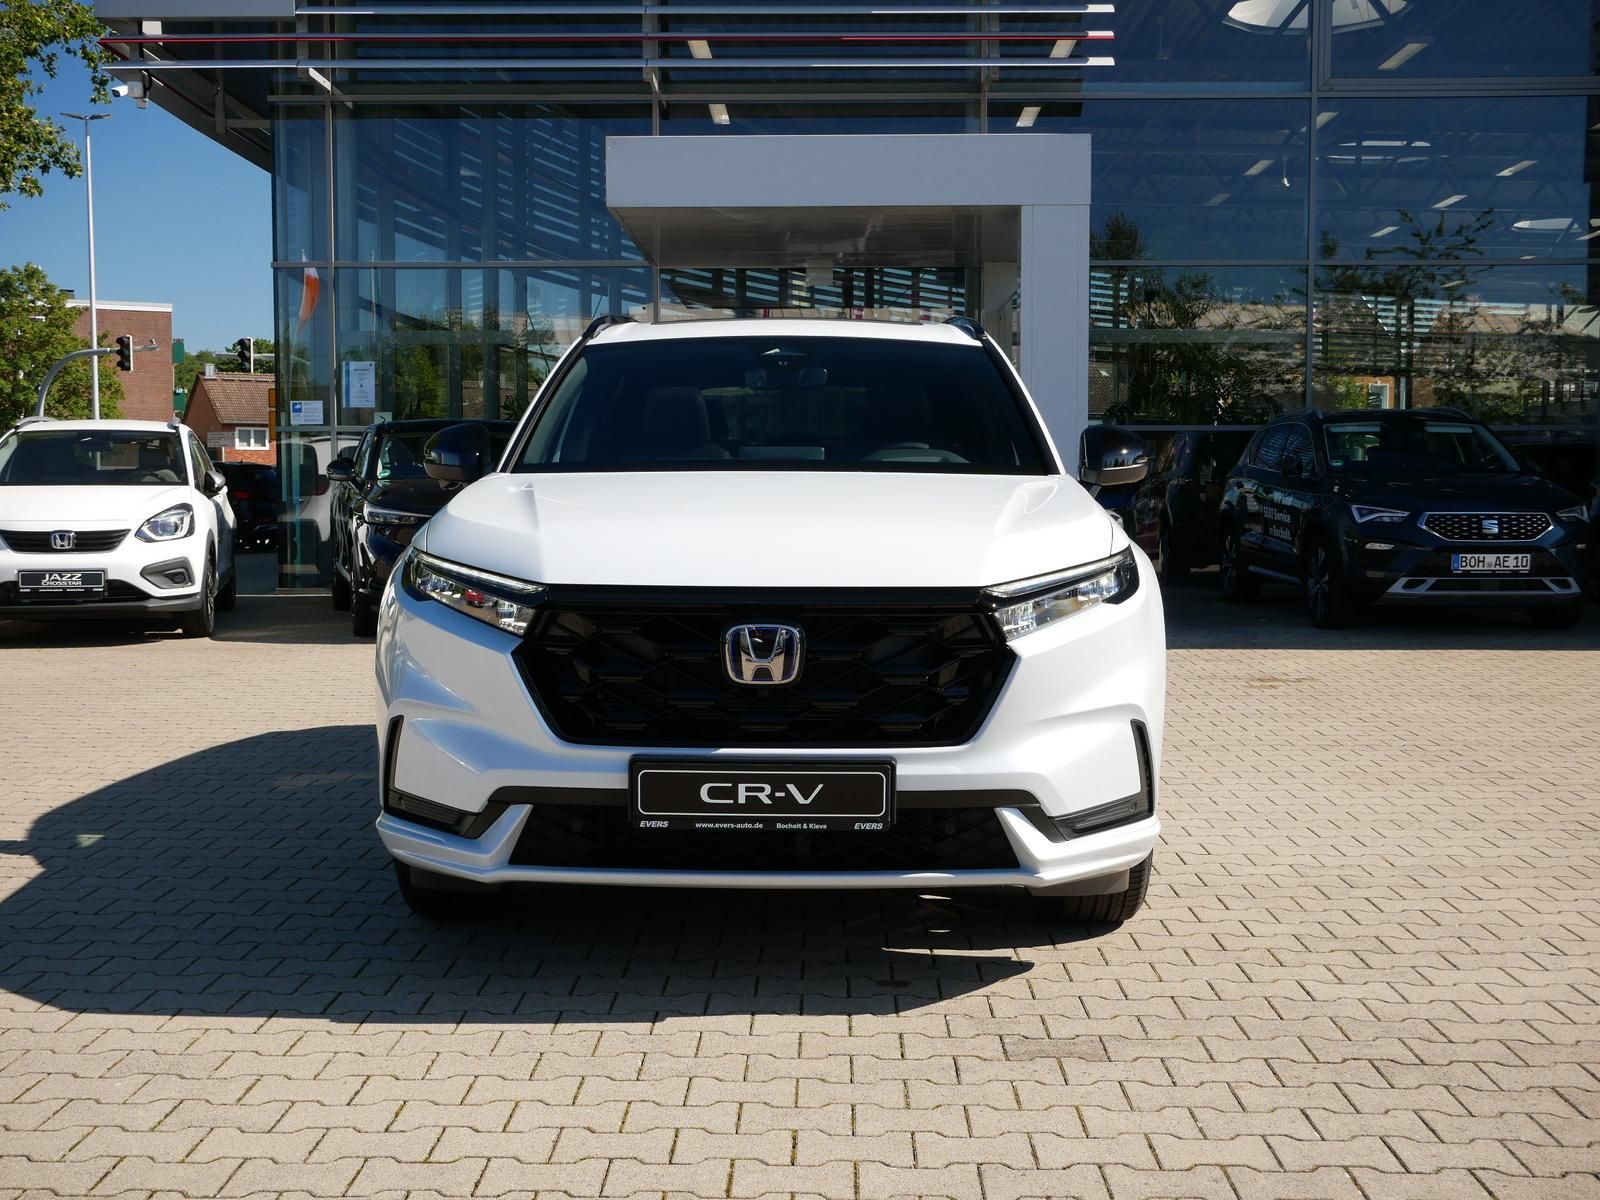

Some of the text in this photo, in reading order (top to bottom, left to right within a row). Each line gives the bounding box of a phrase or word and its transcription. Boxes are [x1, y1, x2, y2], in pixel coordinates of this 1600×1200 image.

[1274, 509, 1291, 523] Service
[1460, 555, 1529, 568] BOH AE 10
[41, 573, 82, 582] JAZZ
[699, 783, 824, 805] CR-V
[639, 820, 669, 828] EVERS
[695, 821, 764, 829] www.evers-auto.de
[854, 822, 883, 830] EVERS
